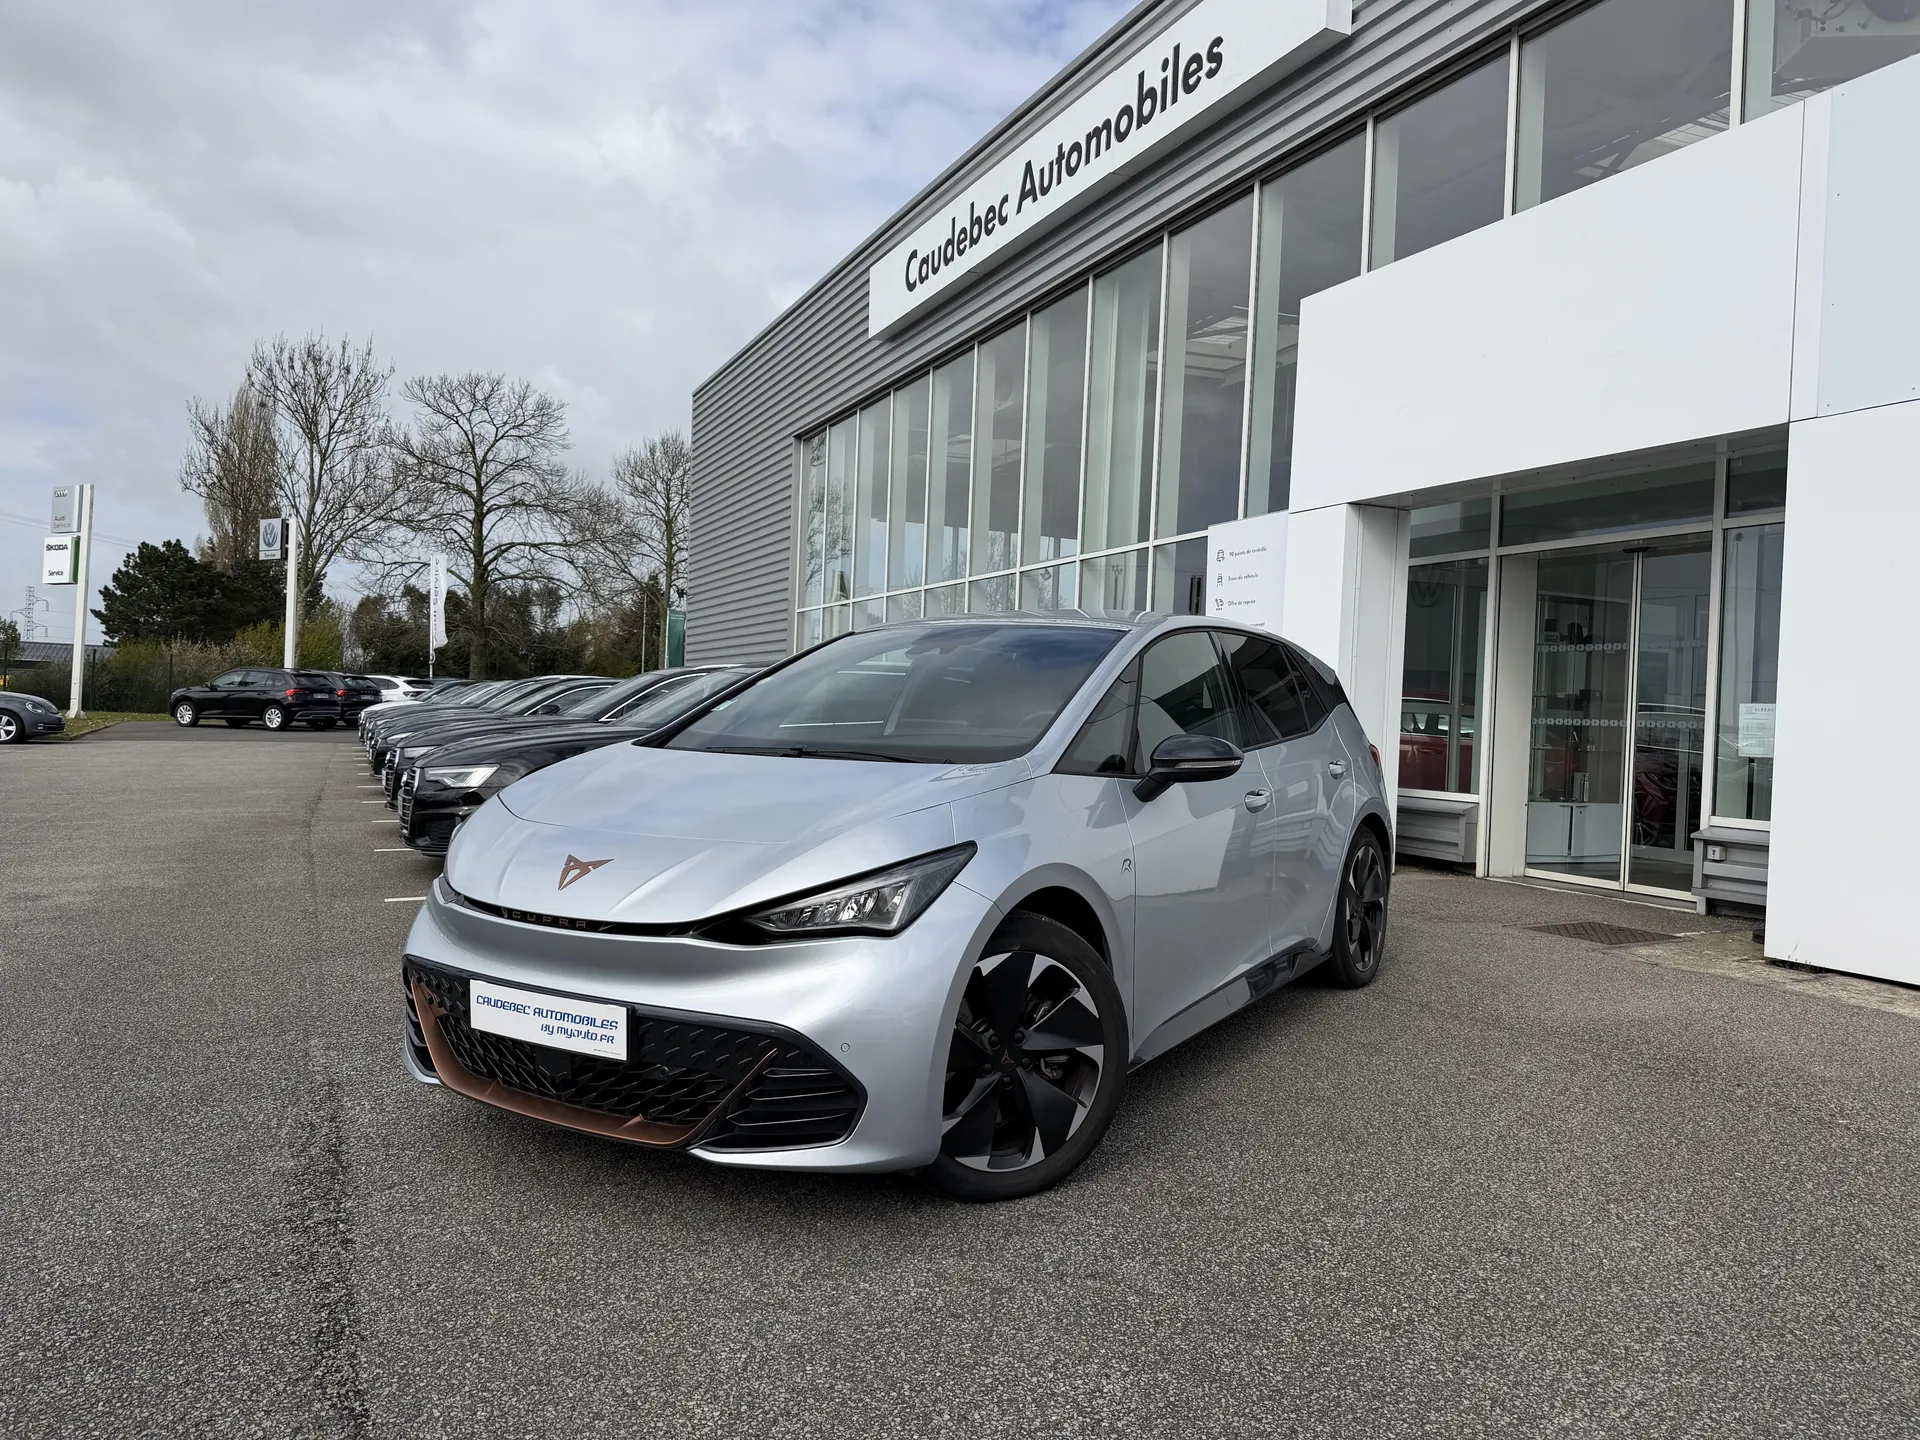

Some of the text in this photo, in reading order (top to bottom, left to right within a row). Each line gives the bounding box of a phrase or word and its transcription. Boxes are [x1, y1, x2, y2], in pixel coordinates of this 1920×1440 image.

[905, 36, 1224, 293] Caudebec Automobiles
[48, 569, 64, 577] Service
[512, 911, 586, 929] CUPRA
[476, 994, 619, 1031] CAUDEBEC AUTOMOBILES
